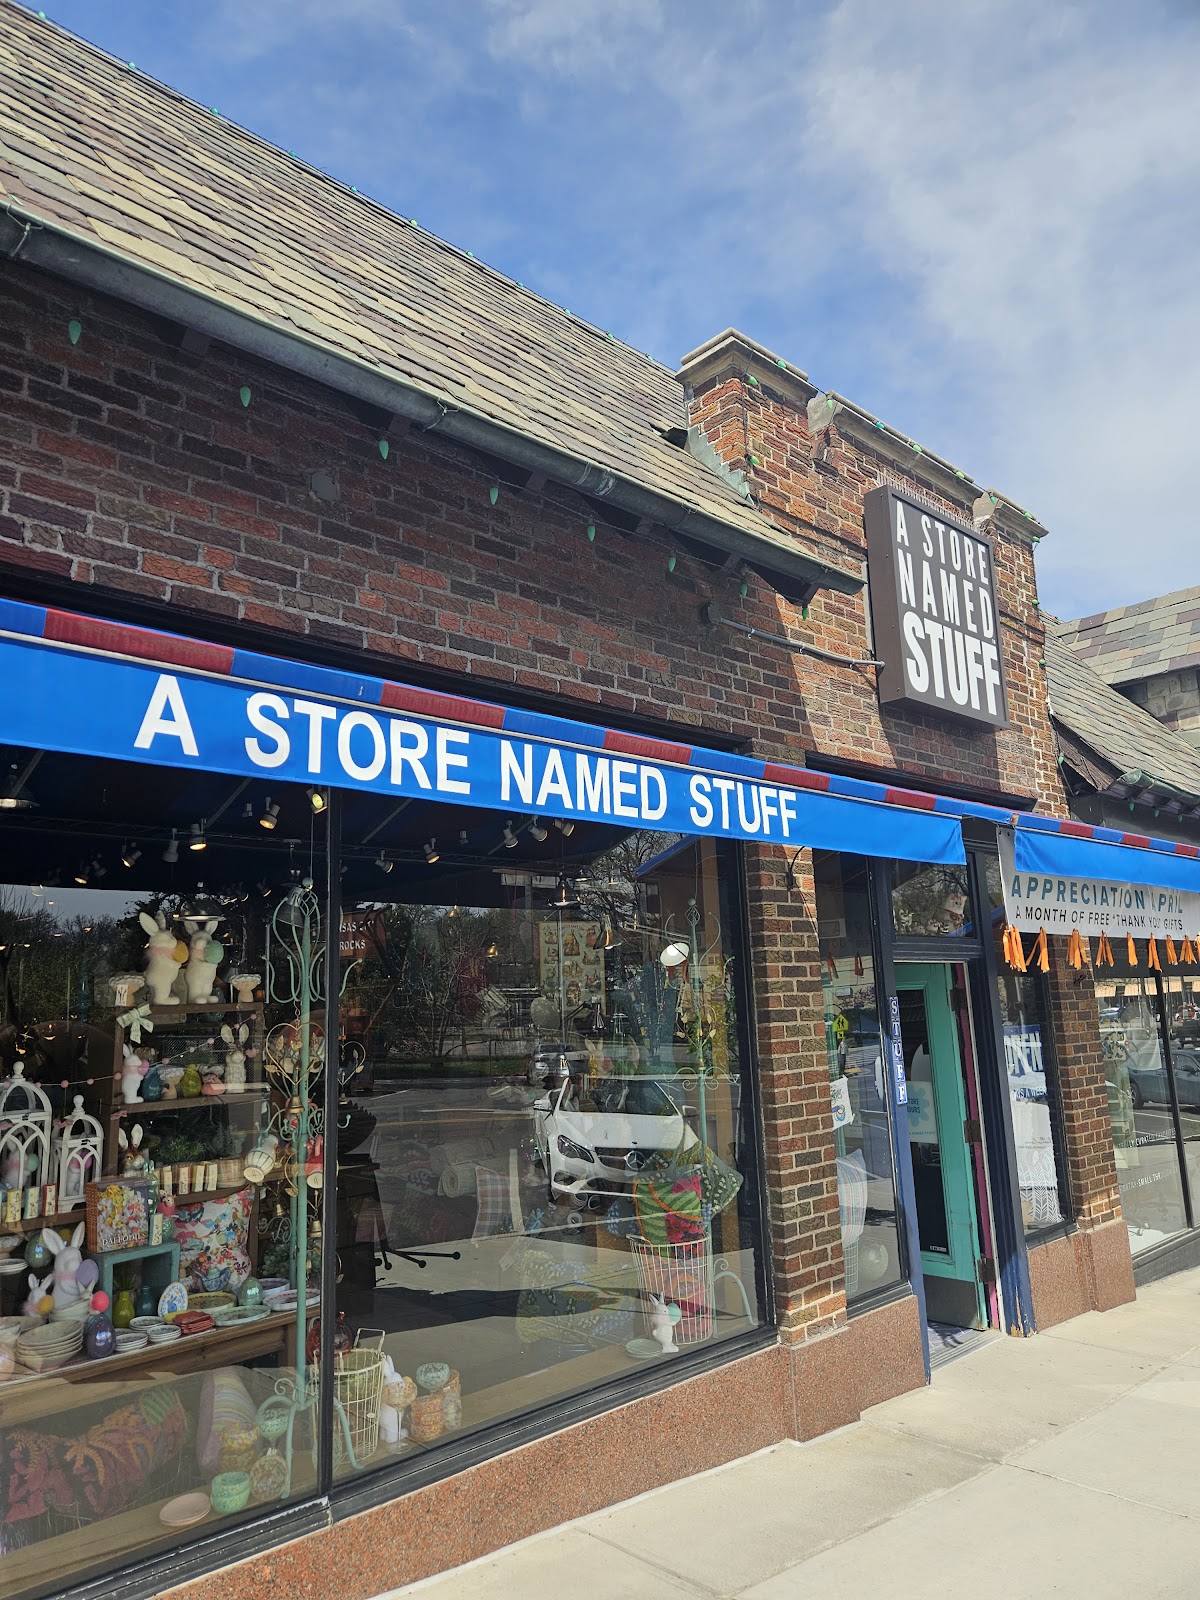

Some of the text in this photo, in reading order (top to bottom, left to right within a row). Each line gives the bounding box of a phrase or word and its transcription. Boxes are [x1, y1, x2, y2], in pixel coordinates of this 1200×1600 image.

[897, 501, 989, 585] A STORE
[898, 548, 994, 639] NAMED
[903, 611, 1001, 716] STUFF
[134, 674, 797, 838] A STORE NAMED STUFF
[1011, 875, 1145, 910] APPRECIATION
[1015, 905, 1022, 919] A
[1025, 906, 1067, 923] MONTH
[1071, 911, 1086, 924] OF
[1088, 912, 1110, 926] FREE
[1163, 918, 1184, 931] GIFTS
[339, 939, 366, 951] ROCKS
[891, 1000, 906, 1102] STUFF
